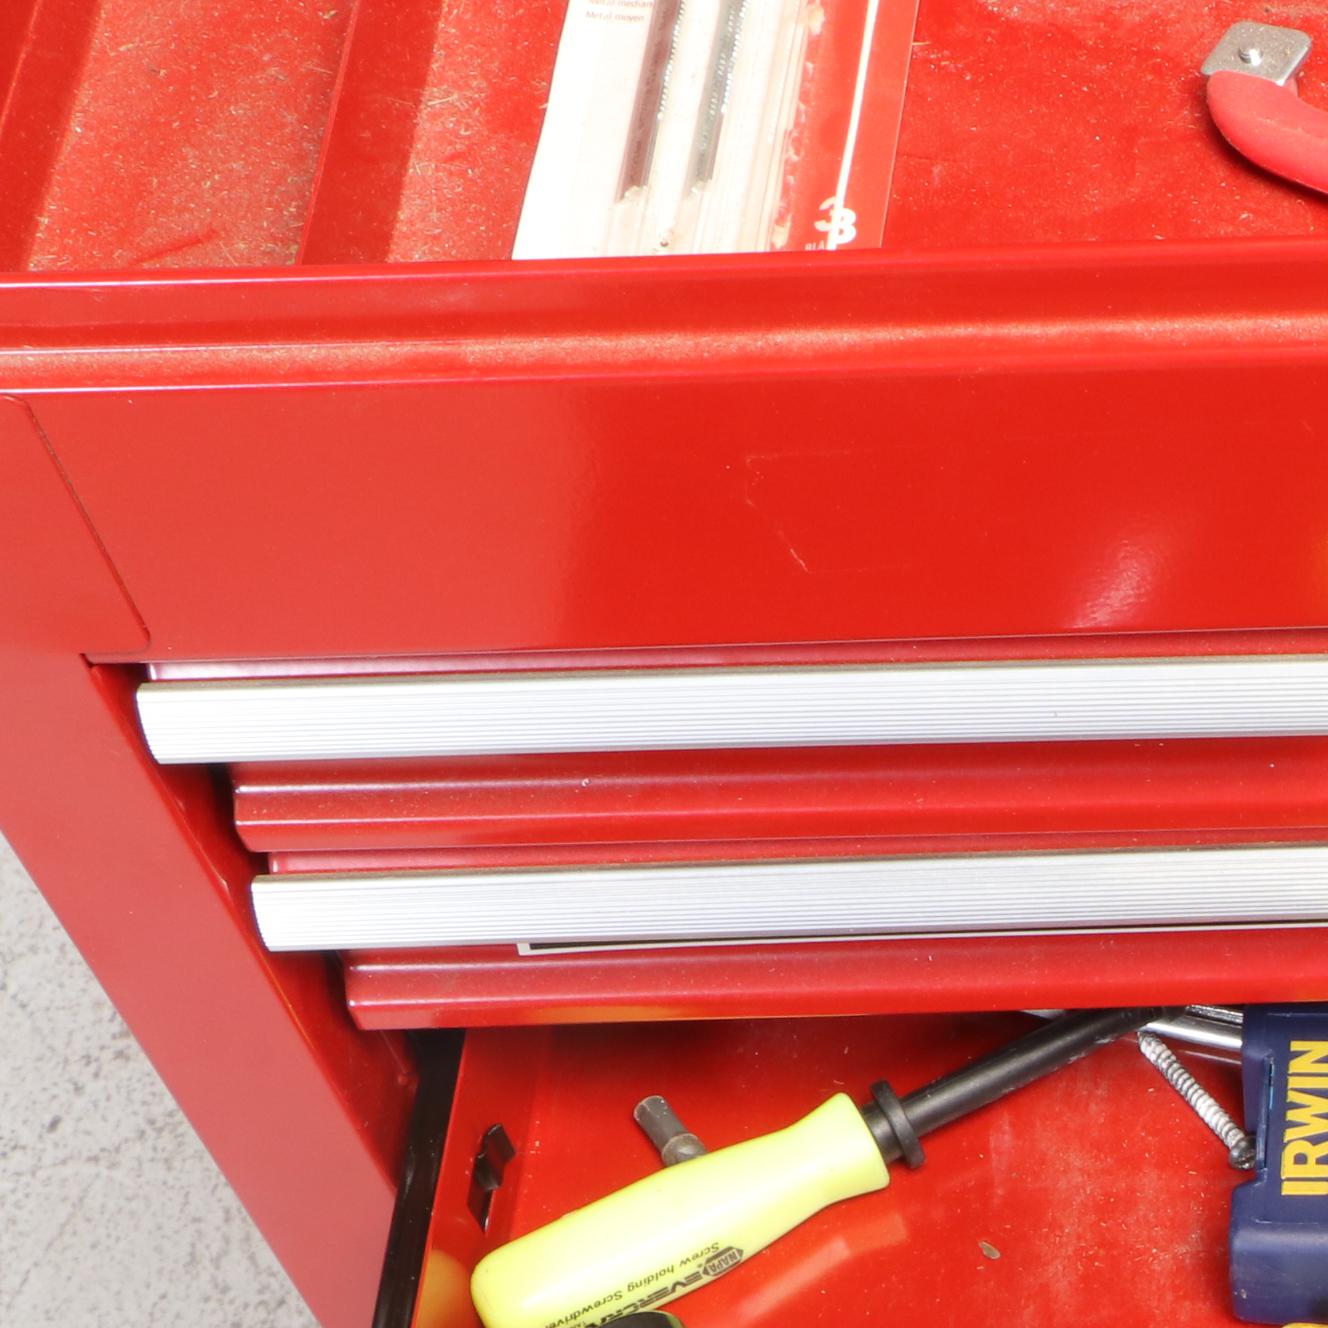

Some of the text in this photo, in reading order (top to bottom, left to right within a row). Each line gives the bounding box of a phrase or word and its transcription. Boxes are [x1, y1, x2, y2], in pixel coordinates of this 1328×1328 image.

[679, 1242, 720, 1268] Screw
[707, 1249, 739, 1274] NAPA
[627, 1264, 676, 1292] holding
